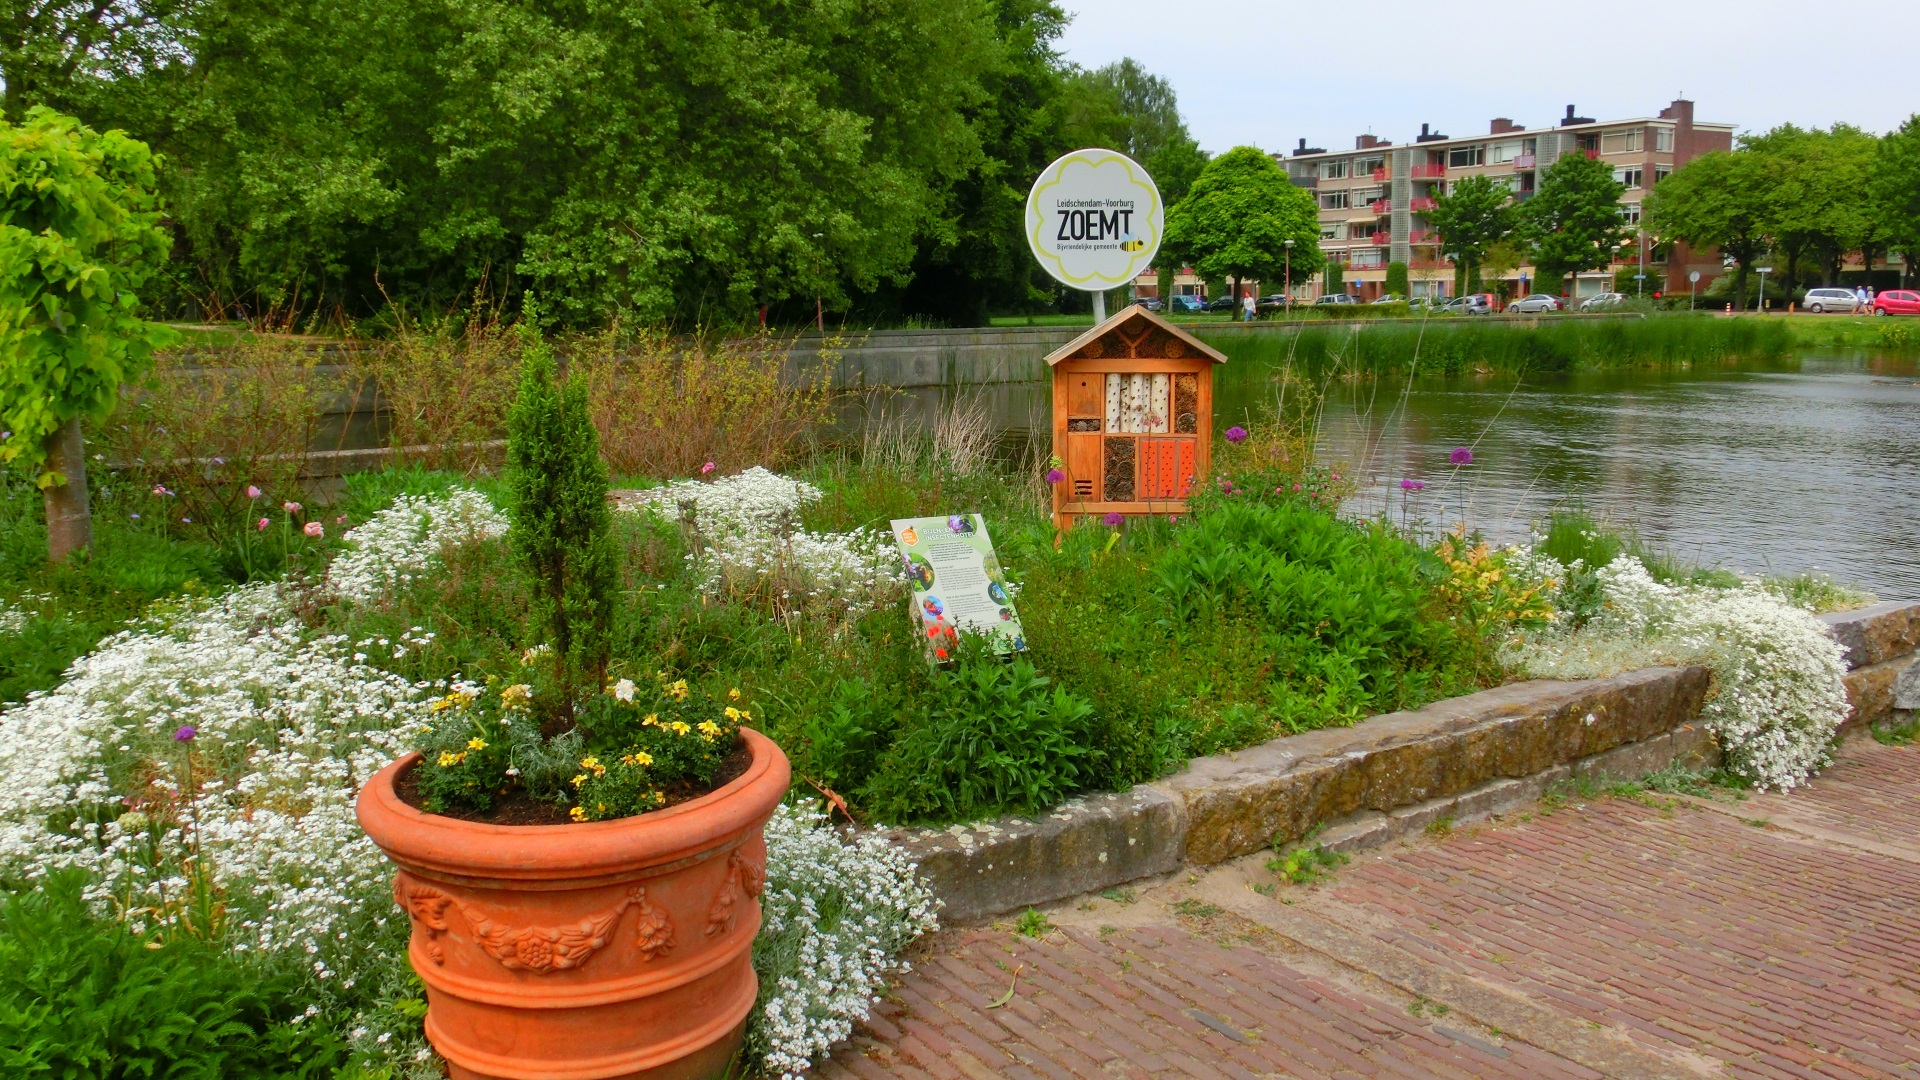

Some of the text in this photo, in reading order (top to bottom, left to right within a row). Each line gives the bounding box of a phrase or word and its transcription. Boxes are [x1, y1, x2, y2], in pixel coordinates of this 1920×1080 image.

[1057, 199, 1134, 209] Leidschendam-Voorburg
[1057, 210, 1133, 240] ZOEMT
[1057, 243, 1092, 251] Bijvriendelijke
